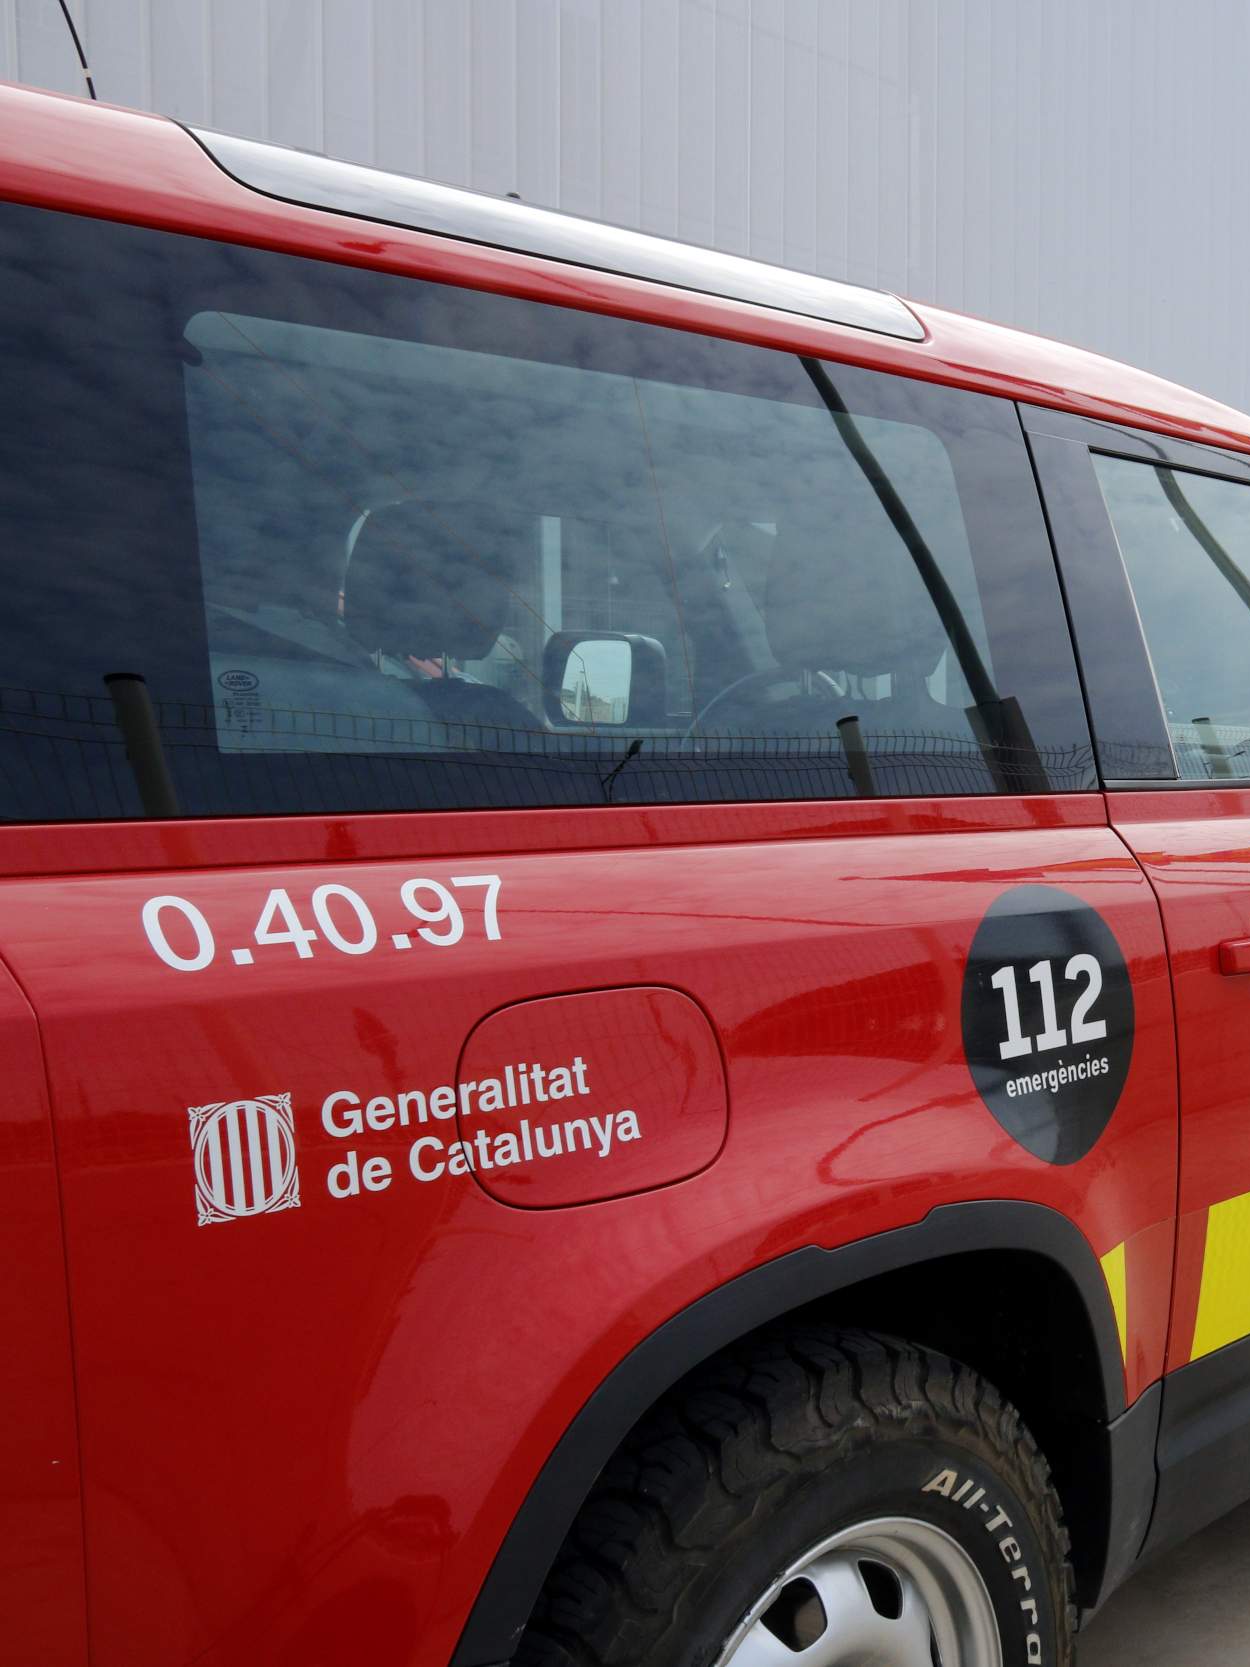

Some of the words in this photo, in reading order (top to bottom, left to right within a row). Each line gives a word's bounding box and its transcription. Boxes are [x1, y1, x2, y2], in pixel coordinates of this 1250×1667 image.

[141, 874, 502, 971] 0.40.97
[990, 953, 1107, 1060] 112
[321, 1056, 590, 1138] Generalitat
[1006, 1053, 1109, 1098] emergències
[327, 1151, 392, 1199] de
[408, 1109, 642, 1182] Catalunya
